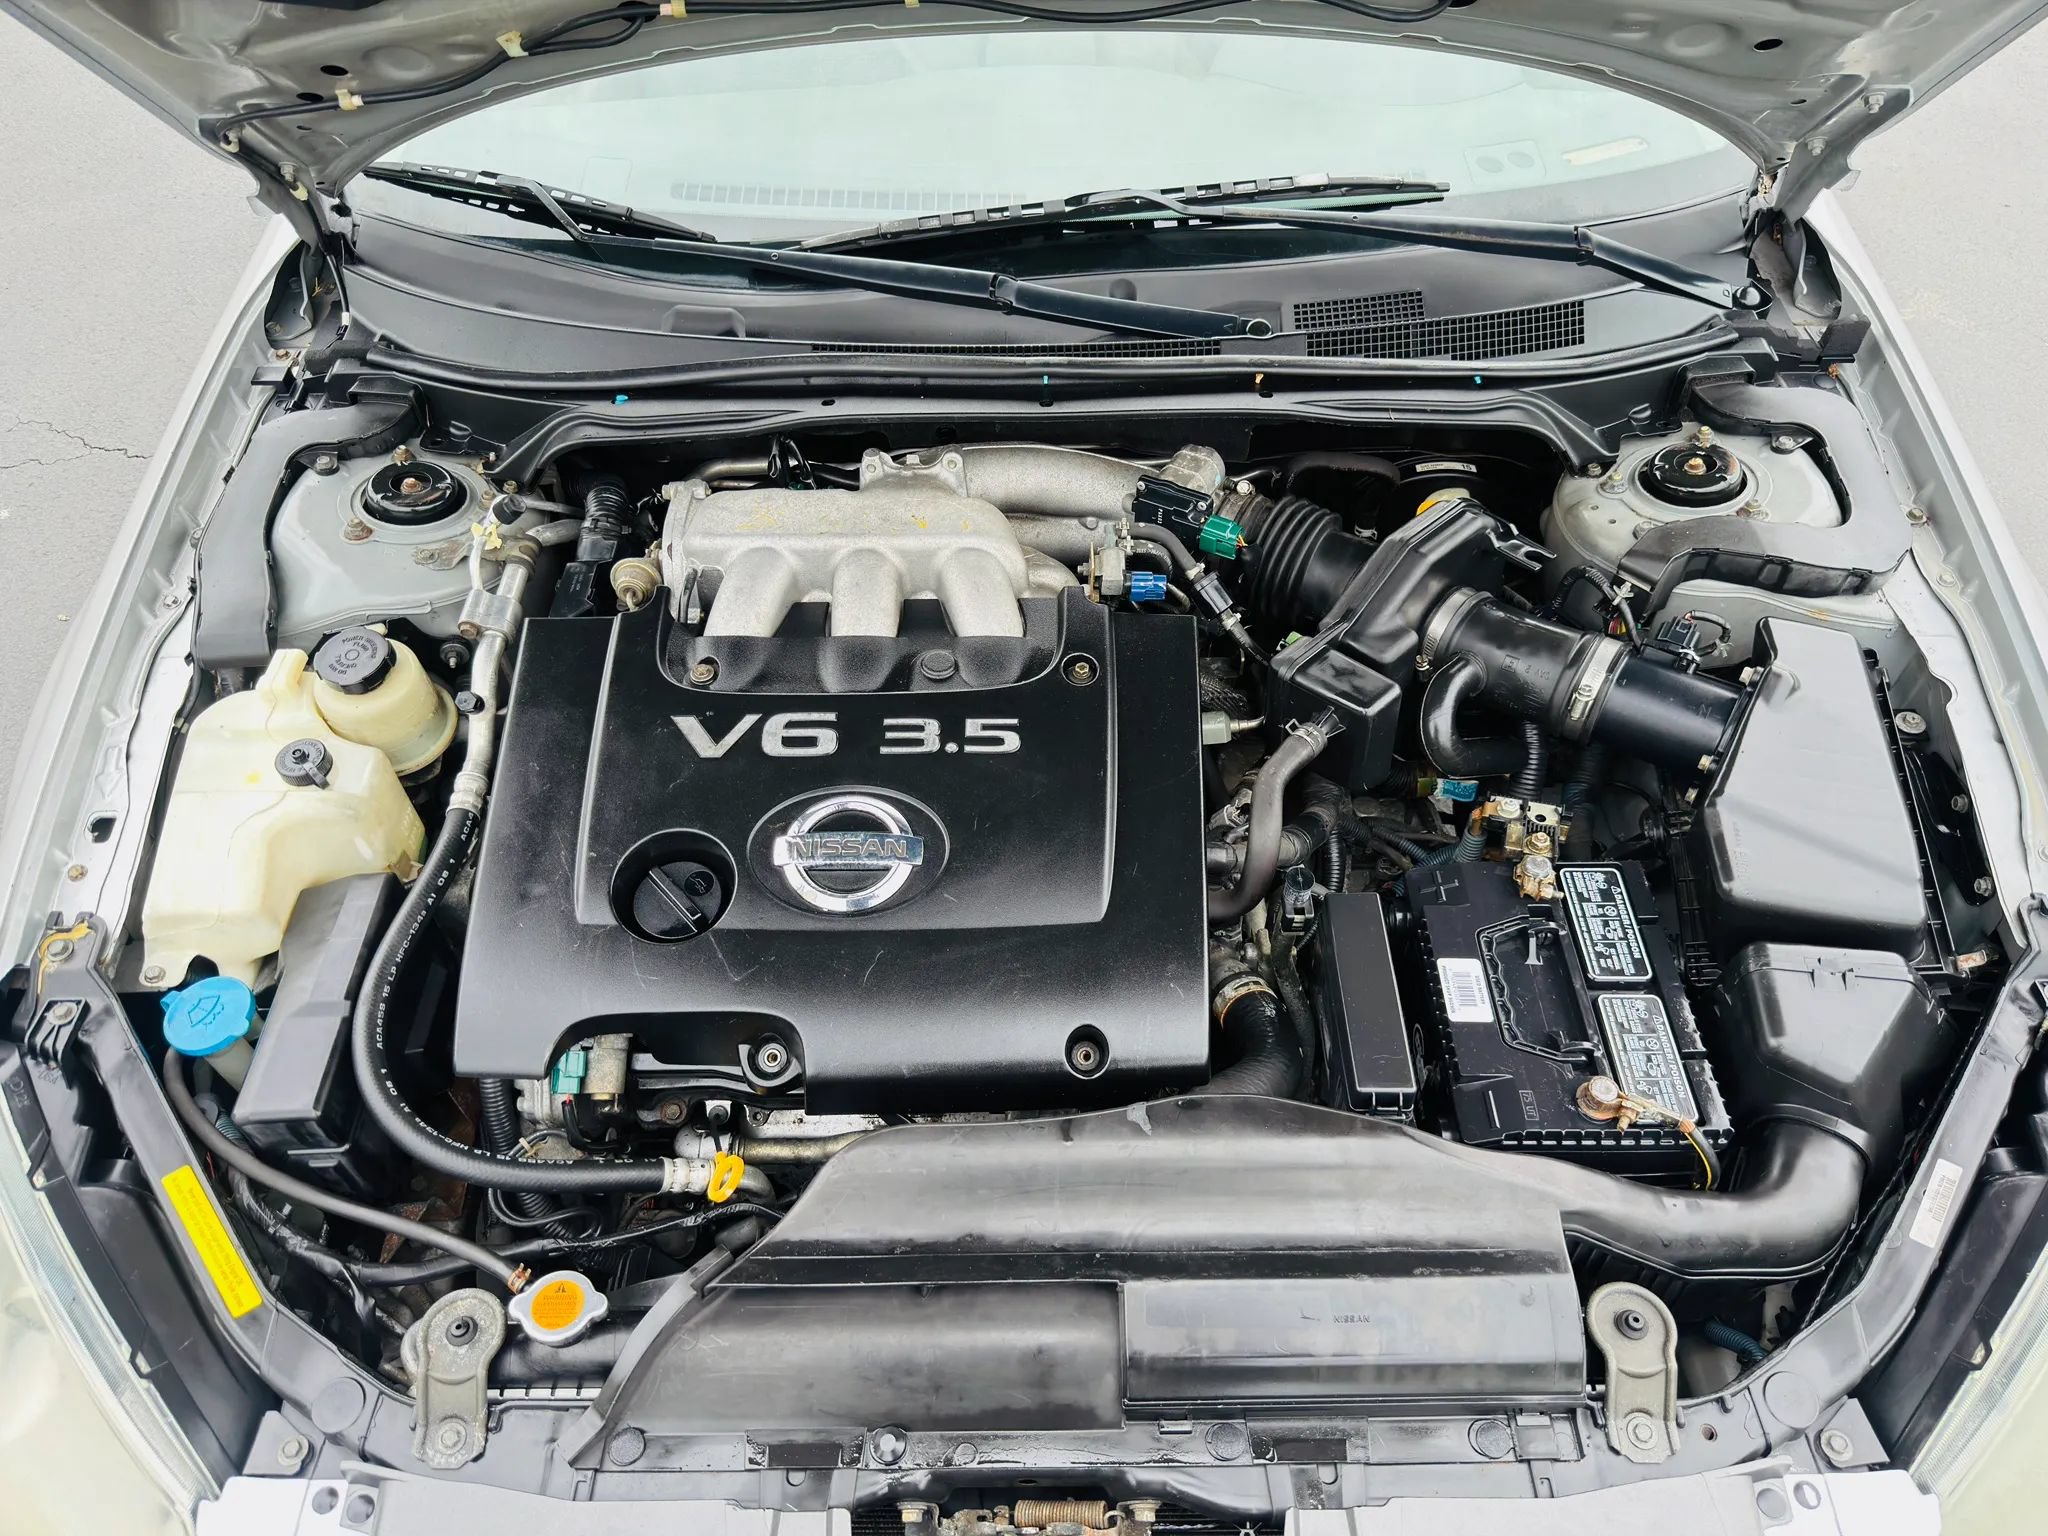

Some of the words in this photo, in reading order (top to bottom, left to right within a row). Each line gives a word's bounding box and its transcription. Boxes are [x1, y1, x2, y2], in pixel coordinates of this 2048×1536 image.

[670, 712, 839, 758] V6
[880, 718, 1021, 754] 3.5
[792, 838, 908, 858] NISSAN
[382, 984, 391, 998] 15
[387, 966, 397, 981] LP
[395, 910, 427, 962] HFC-134a
[1614, 894, 1642, 959] DANGER/POISON
[1656, 1024, 1687, 1099] DANGER/POISON
[1333, 1314, 1372, 1324] NISSAN
